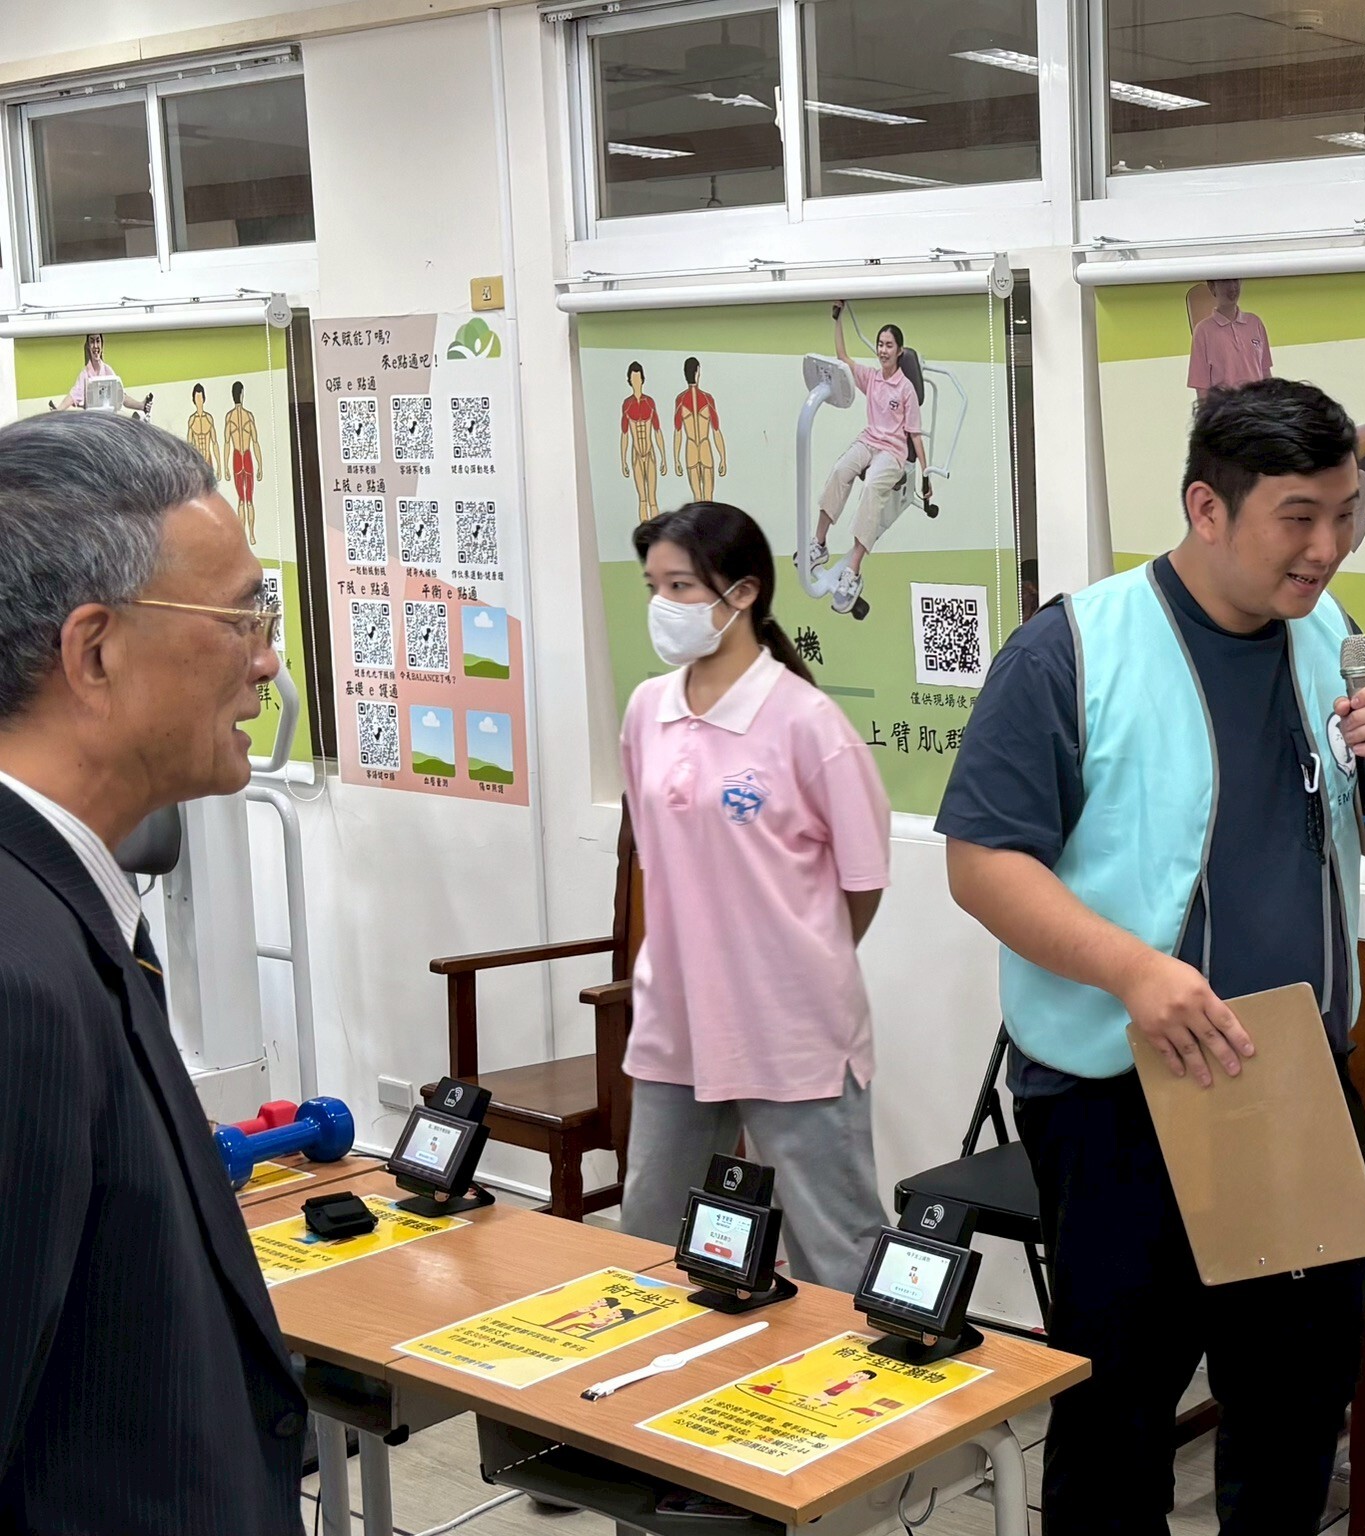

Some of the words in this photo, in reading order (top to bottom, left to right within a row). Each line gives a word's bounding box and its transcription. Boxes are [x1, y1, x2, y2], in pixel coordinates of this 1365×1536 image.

[321, 330, 391, 347] 今天賦能了嗎?
[326, 377, 342, 391] Q彈
[347, 379, 352, 391] e
[357, 376, 377, 391] 點通
[333, 478, 352, 492] 上肢
[357, 481, 362, 492] e
[367, 478, 387, 493] 點通
[337, 581, 356, 595] 下肢
[361, 585, 366, 595] e
[370, 582, 391, 597] 點通
[422, 584, 442, 599] 平衡
[447, 588, 453, 599] e
[457, 586, 478, 601] 點通
[794, 626, 823, 665] 機
[346, 681, 364, 696] 基礎
[369, 685, 375, 695] e
[602, 1283, 679, 1309] 椅子坐立
